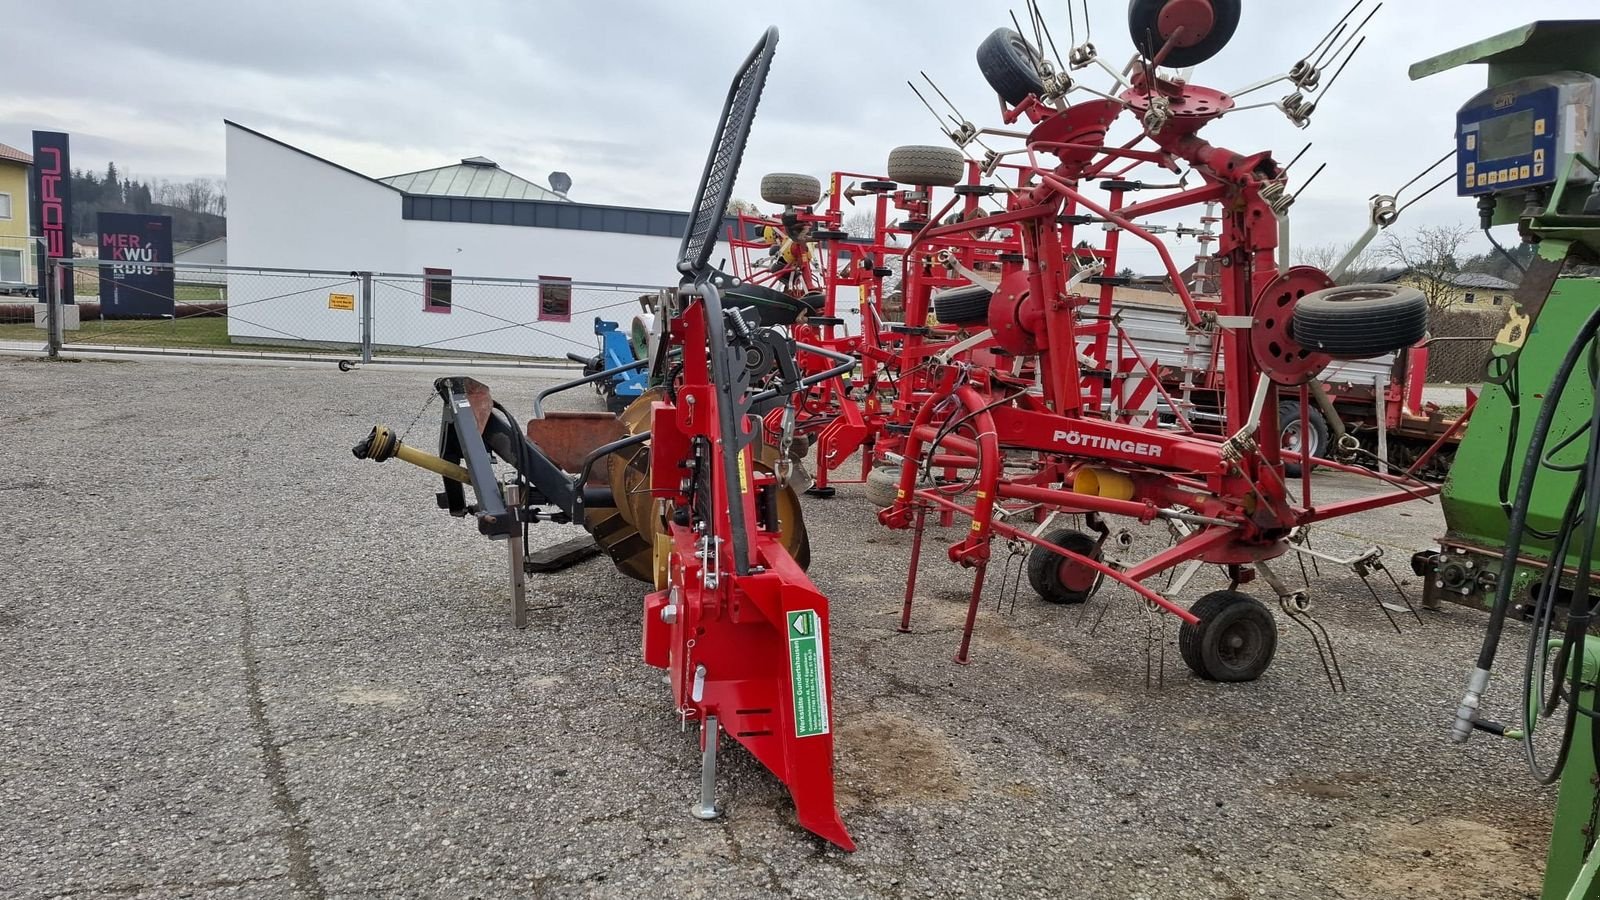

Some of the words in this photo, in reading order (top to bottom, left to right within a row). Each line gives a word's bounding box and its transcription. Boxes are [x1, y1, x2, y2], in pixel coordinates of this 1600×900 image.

[103, 233, 140, 247] MER
[1053, 430, 1162, 457] PÖTTINGER
[794, 640, 803, 696] Gundertshausen
[798, 696, 806, 732] Werkstätte
